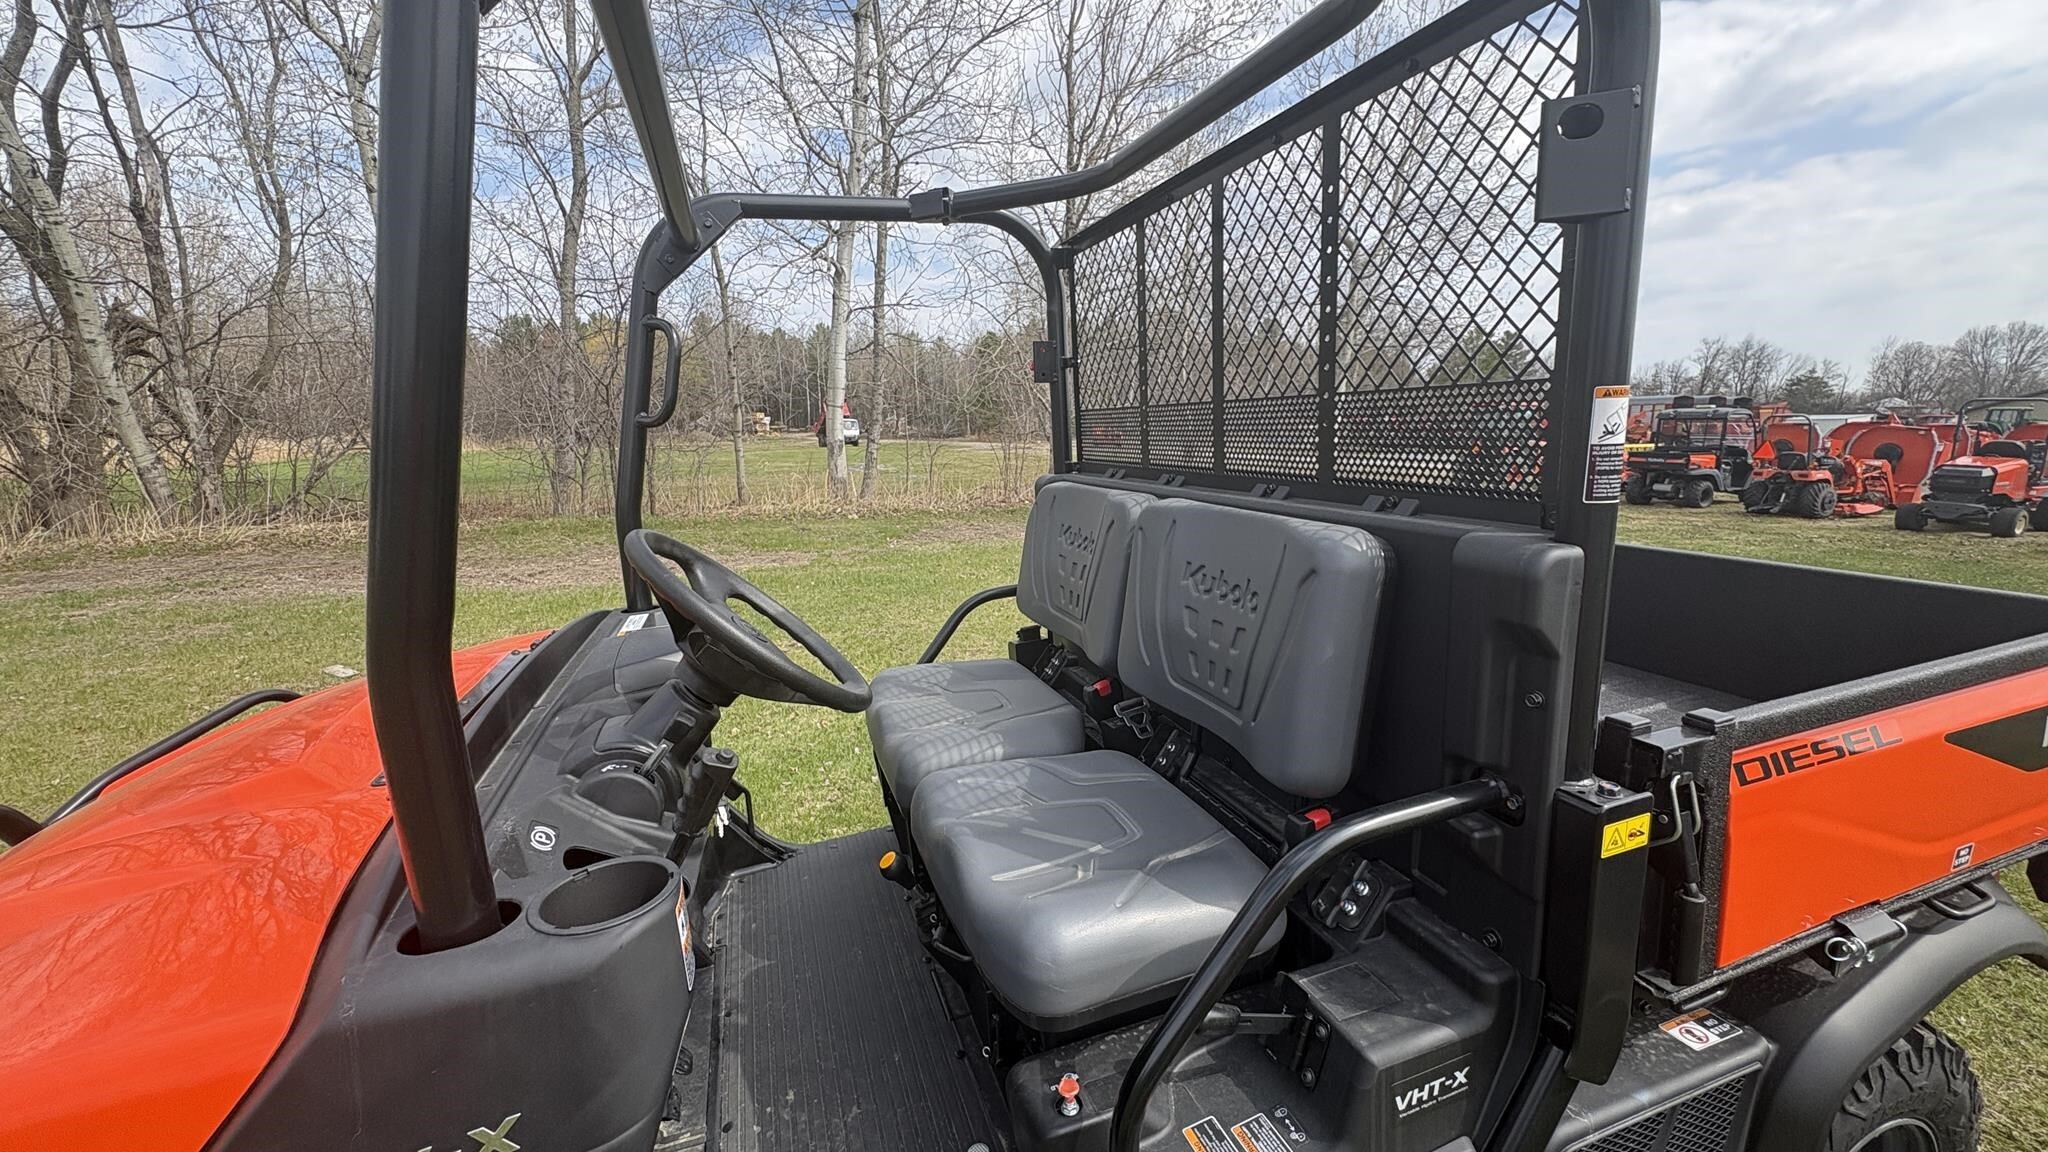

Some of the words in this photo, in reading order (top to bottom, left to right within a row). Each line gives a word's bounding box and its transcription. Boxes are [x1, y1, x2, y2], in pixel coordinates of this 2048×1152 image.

[1181, 560, 1259, 617] Kubota
[1733, 724, 1903, 787] DIESEL
[1959, 847, 1970, 856] NO
[1954, 855, 1970, 867] STEP
[1703, 1018, 1719, 1028] NO
[1709, 1023, 1732, 1036] STEP
[1395, 1066, 1470, 1111] VHT-X
